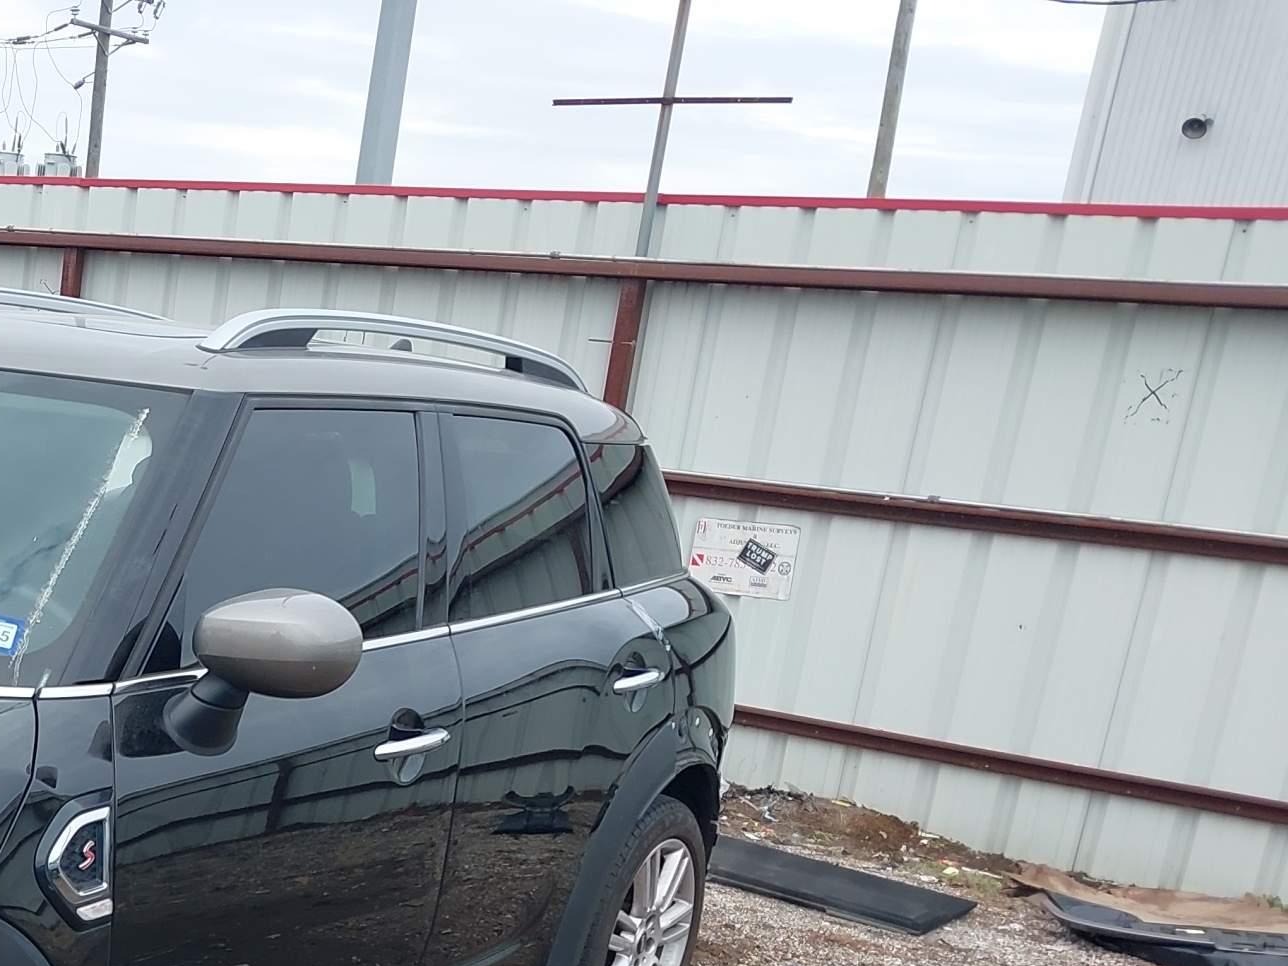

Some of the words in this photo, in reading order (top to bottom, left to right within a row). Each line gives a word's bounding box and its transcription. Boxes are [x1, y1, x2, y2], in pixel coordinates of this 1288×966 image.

[742, 524, 767, 533] MARINE
[768, 527, 798, 535] SURVEYS
[746, 550, 767, 567] LOST
[747, 541, 774, 561] TRUMP
[77, 840, 96, 871] S
